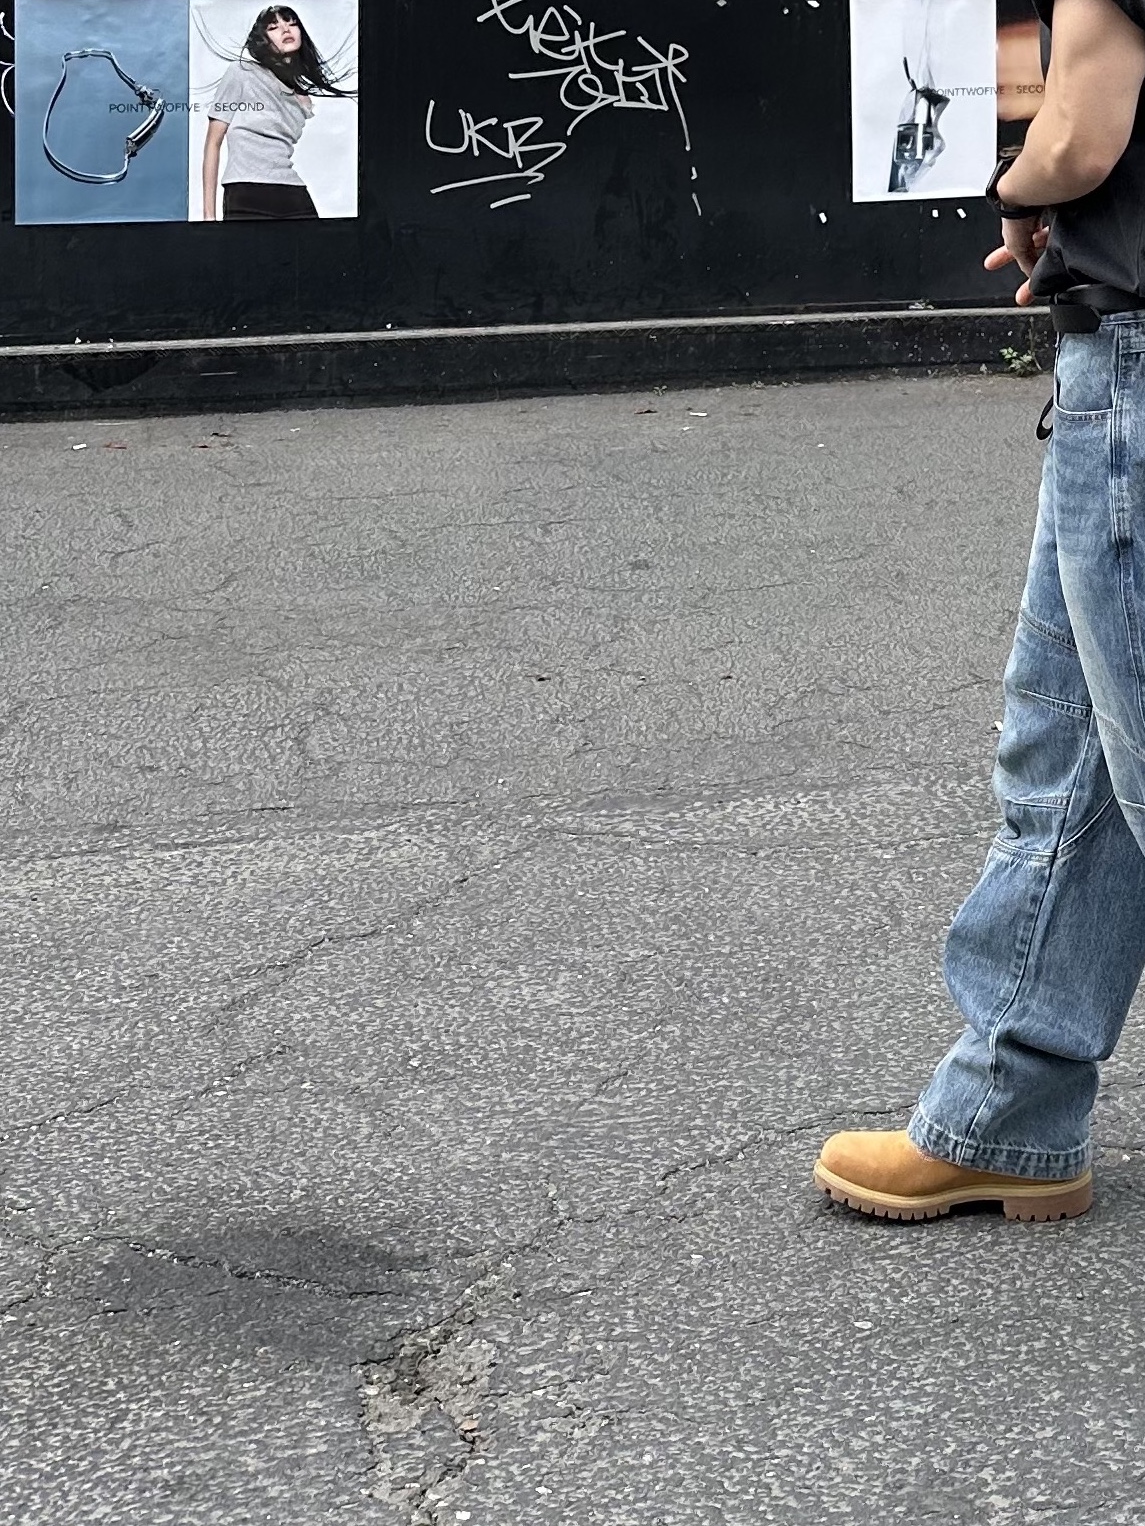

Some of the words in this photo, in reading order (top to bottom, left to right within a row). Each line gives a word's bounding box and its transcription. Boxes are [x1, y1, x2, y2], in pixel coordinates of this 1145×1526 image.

[1016, 84, 1045, 94] SECO
[109, 103, 201, 114] POINTOFIVE
[215, 102, 265, 112] SECOND
